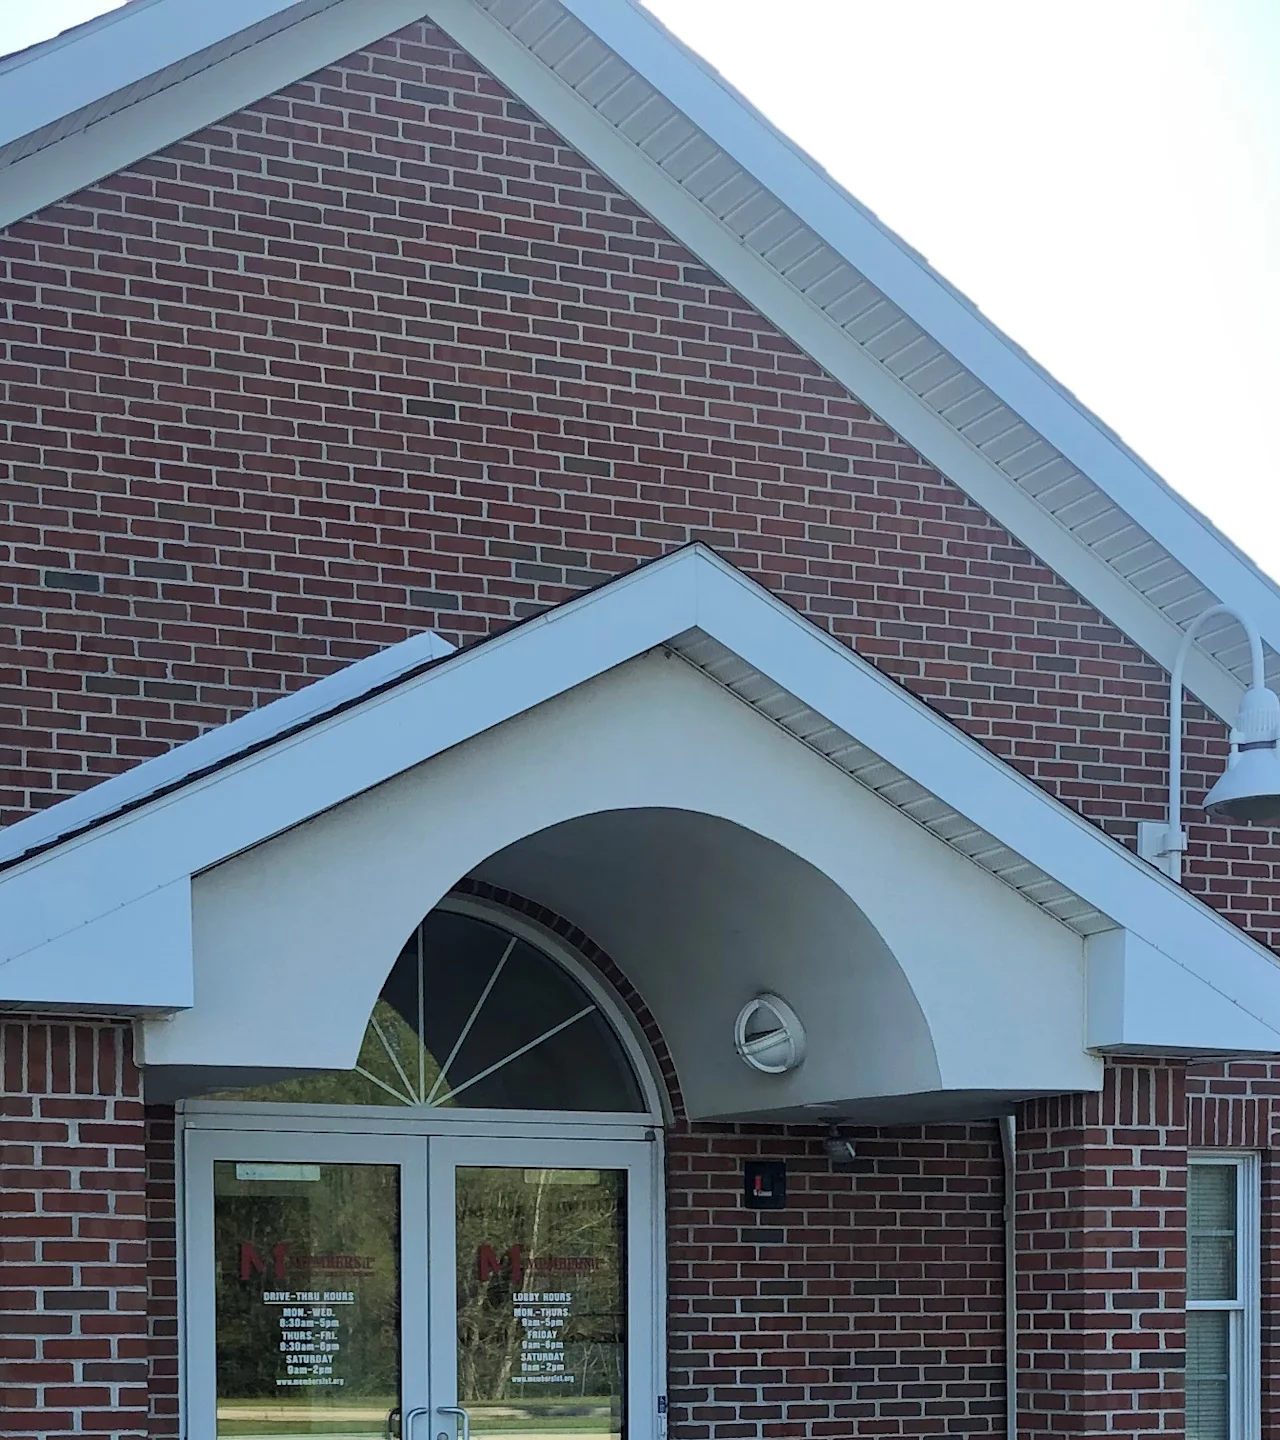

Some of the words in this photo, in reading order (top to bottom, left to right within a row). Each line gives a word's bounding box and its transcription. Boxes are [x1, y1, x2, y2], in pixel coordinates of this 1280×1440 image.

[263, 1292, 320, 1301] DRIVE-THRU
[323, 1292, 354, 1301] HOURS
[513, 1292, 540, 1302] LOBBY
[543, 1292, 572, 1302] HOURS
[283, 1308, 336, 1317] MON.-WED.
[513, 1308, 571, 1317] MON.-THURS.
[282, 1331, 338, 1340] THURS.-FRI.
[527, 1330, 558, 1339] FRIDAY
[286, 1354, 334, 1364] SATURDAY
[520, 1353, 565, 1362] SATURDAY
